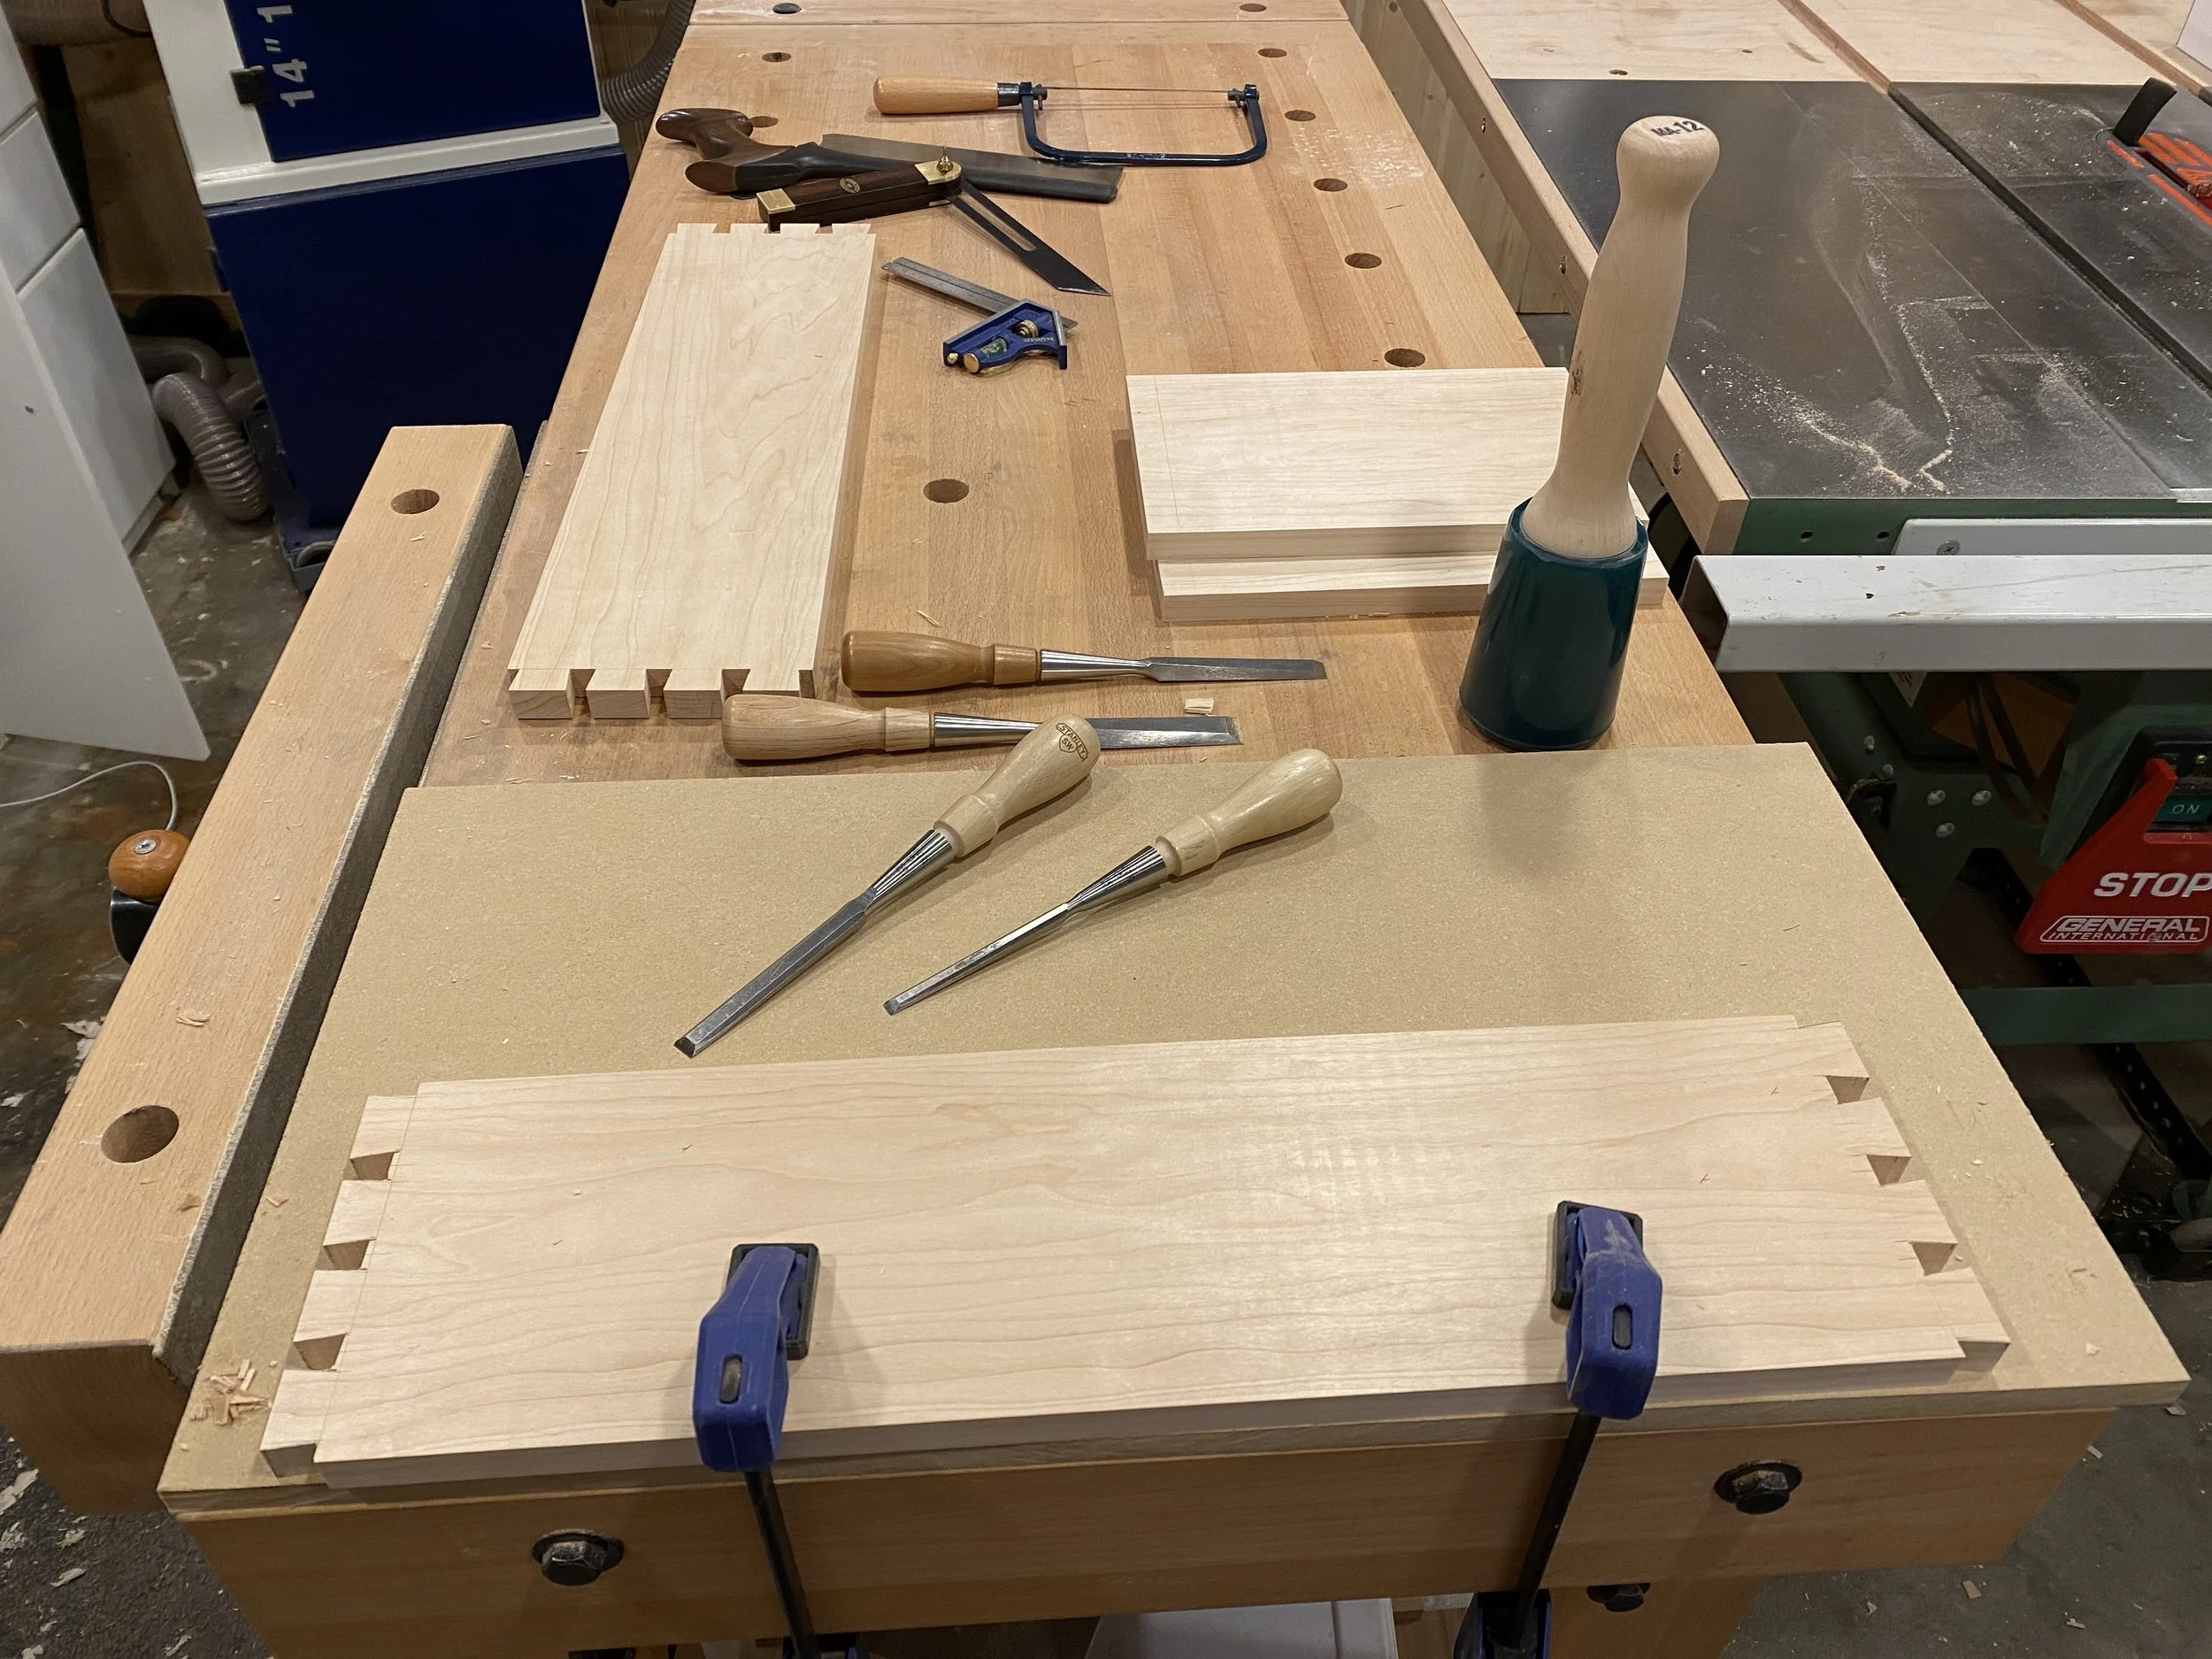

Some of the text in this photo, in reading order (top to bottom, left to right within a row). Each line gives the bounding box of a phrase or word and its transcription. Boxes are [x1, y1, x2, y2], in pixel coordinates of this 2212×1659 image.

[1059, 725, 1087, 755] STANLEY
[2171, 804, 2200, 815] ON
[2093, 872, 2212, 897] STOP
[2055, 918, 2200, 933] GENERAL
